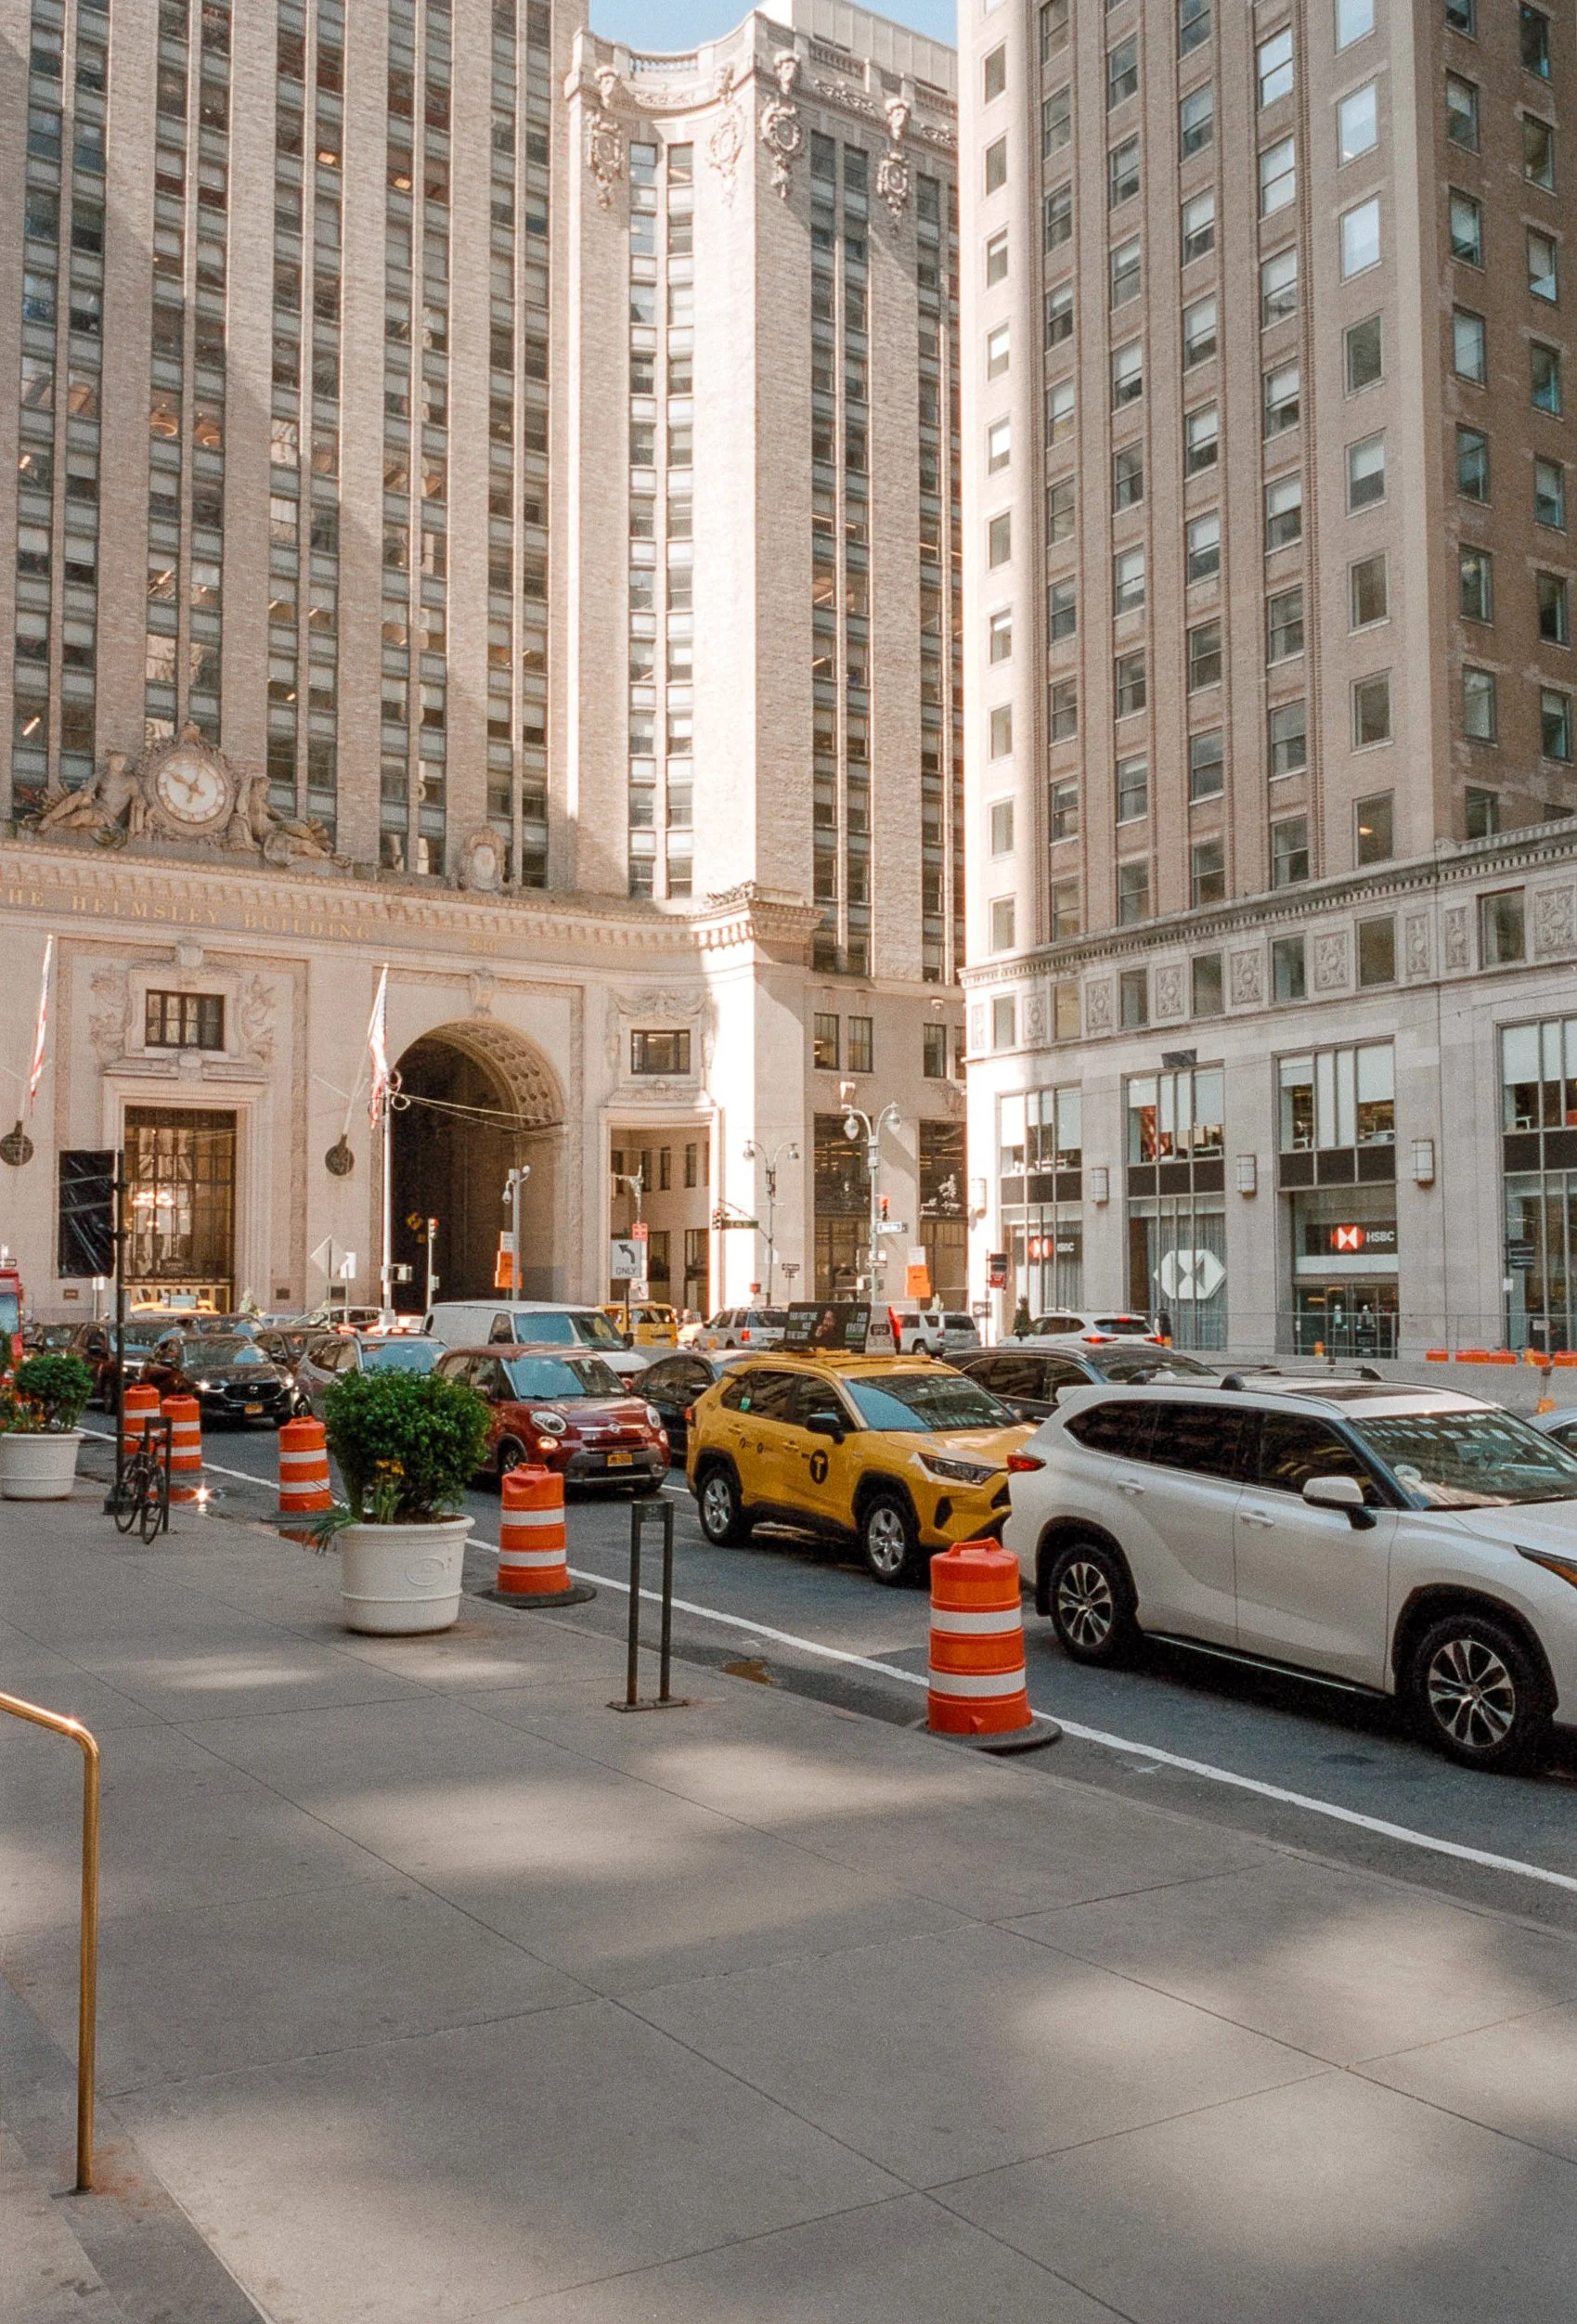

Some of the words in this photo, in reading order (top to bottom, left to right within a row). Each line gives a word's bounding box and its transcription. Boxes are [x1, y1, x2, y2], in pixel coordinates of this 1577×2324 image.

[0, 887, 45, 907] HE
[72, 895, 219, 923] HELMSLEY
[243, 913, 369, 939] BUILDING
[1365, 1231, 1395, 1242] HSBC
[615, 1266, 637, 1275] ONLY
